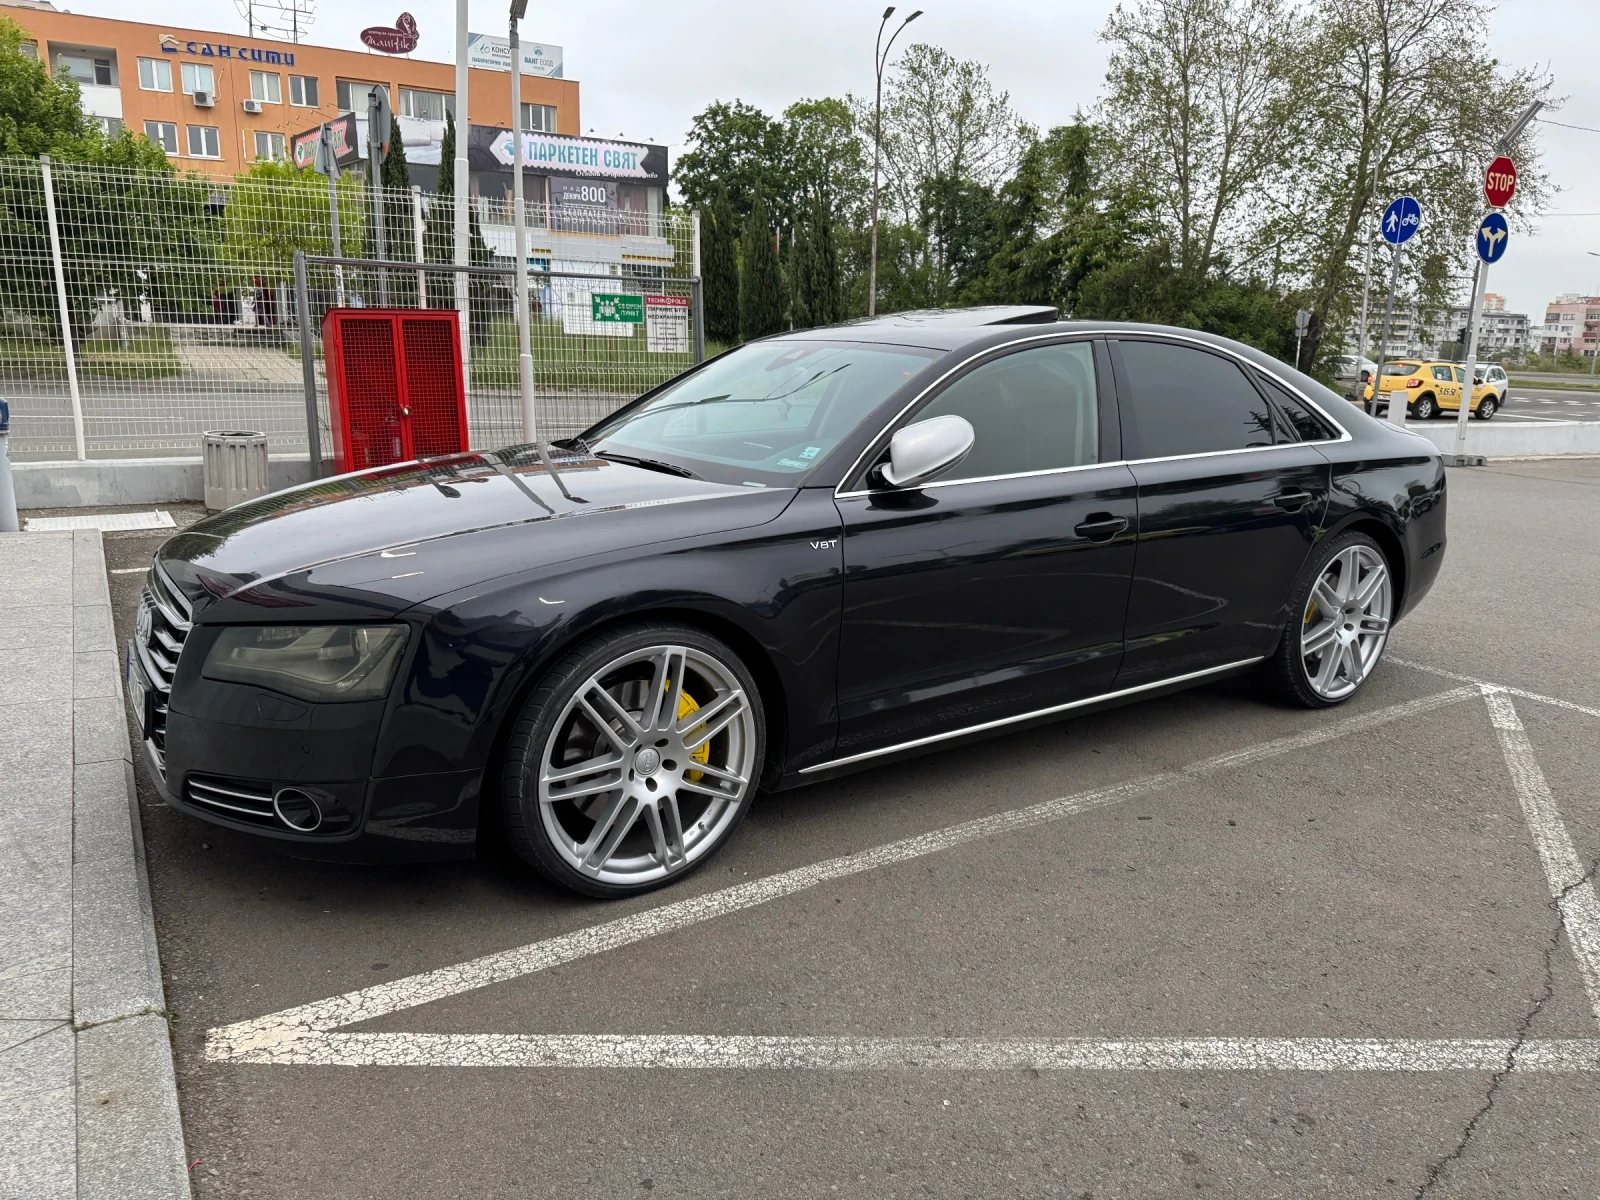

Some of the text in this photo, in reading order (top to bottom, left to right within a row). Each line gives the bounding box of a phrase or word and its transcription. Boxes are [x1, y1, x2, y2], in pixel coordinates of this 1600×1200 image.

[491, 46, 511, 55] КОНСУ
[524, 56, 539, 65] ВАНГ
[528, 141, 637, 170] ПАРКЕТЕН СВЯТ
[1487, 172, 1514, 192] STOP
[563, 186, 606, 203] ДЕКОРА 800
[563, 207, 607, 218] БЕЗПЛАТЕН
[647, 297, 687, 305] TECHNOPOLIS
[810, 540, 837, 550] V8T
